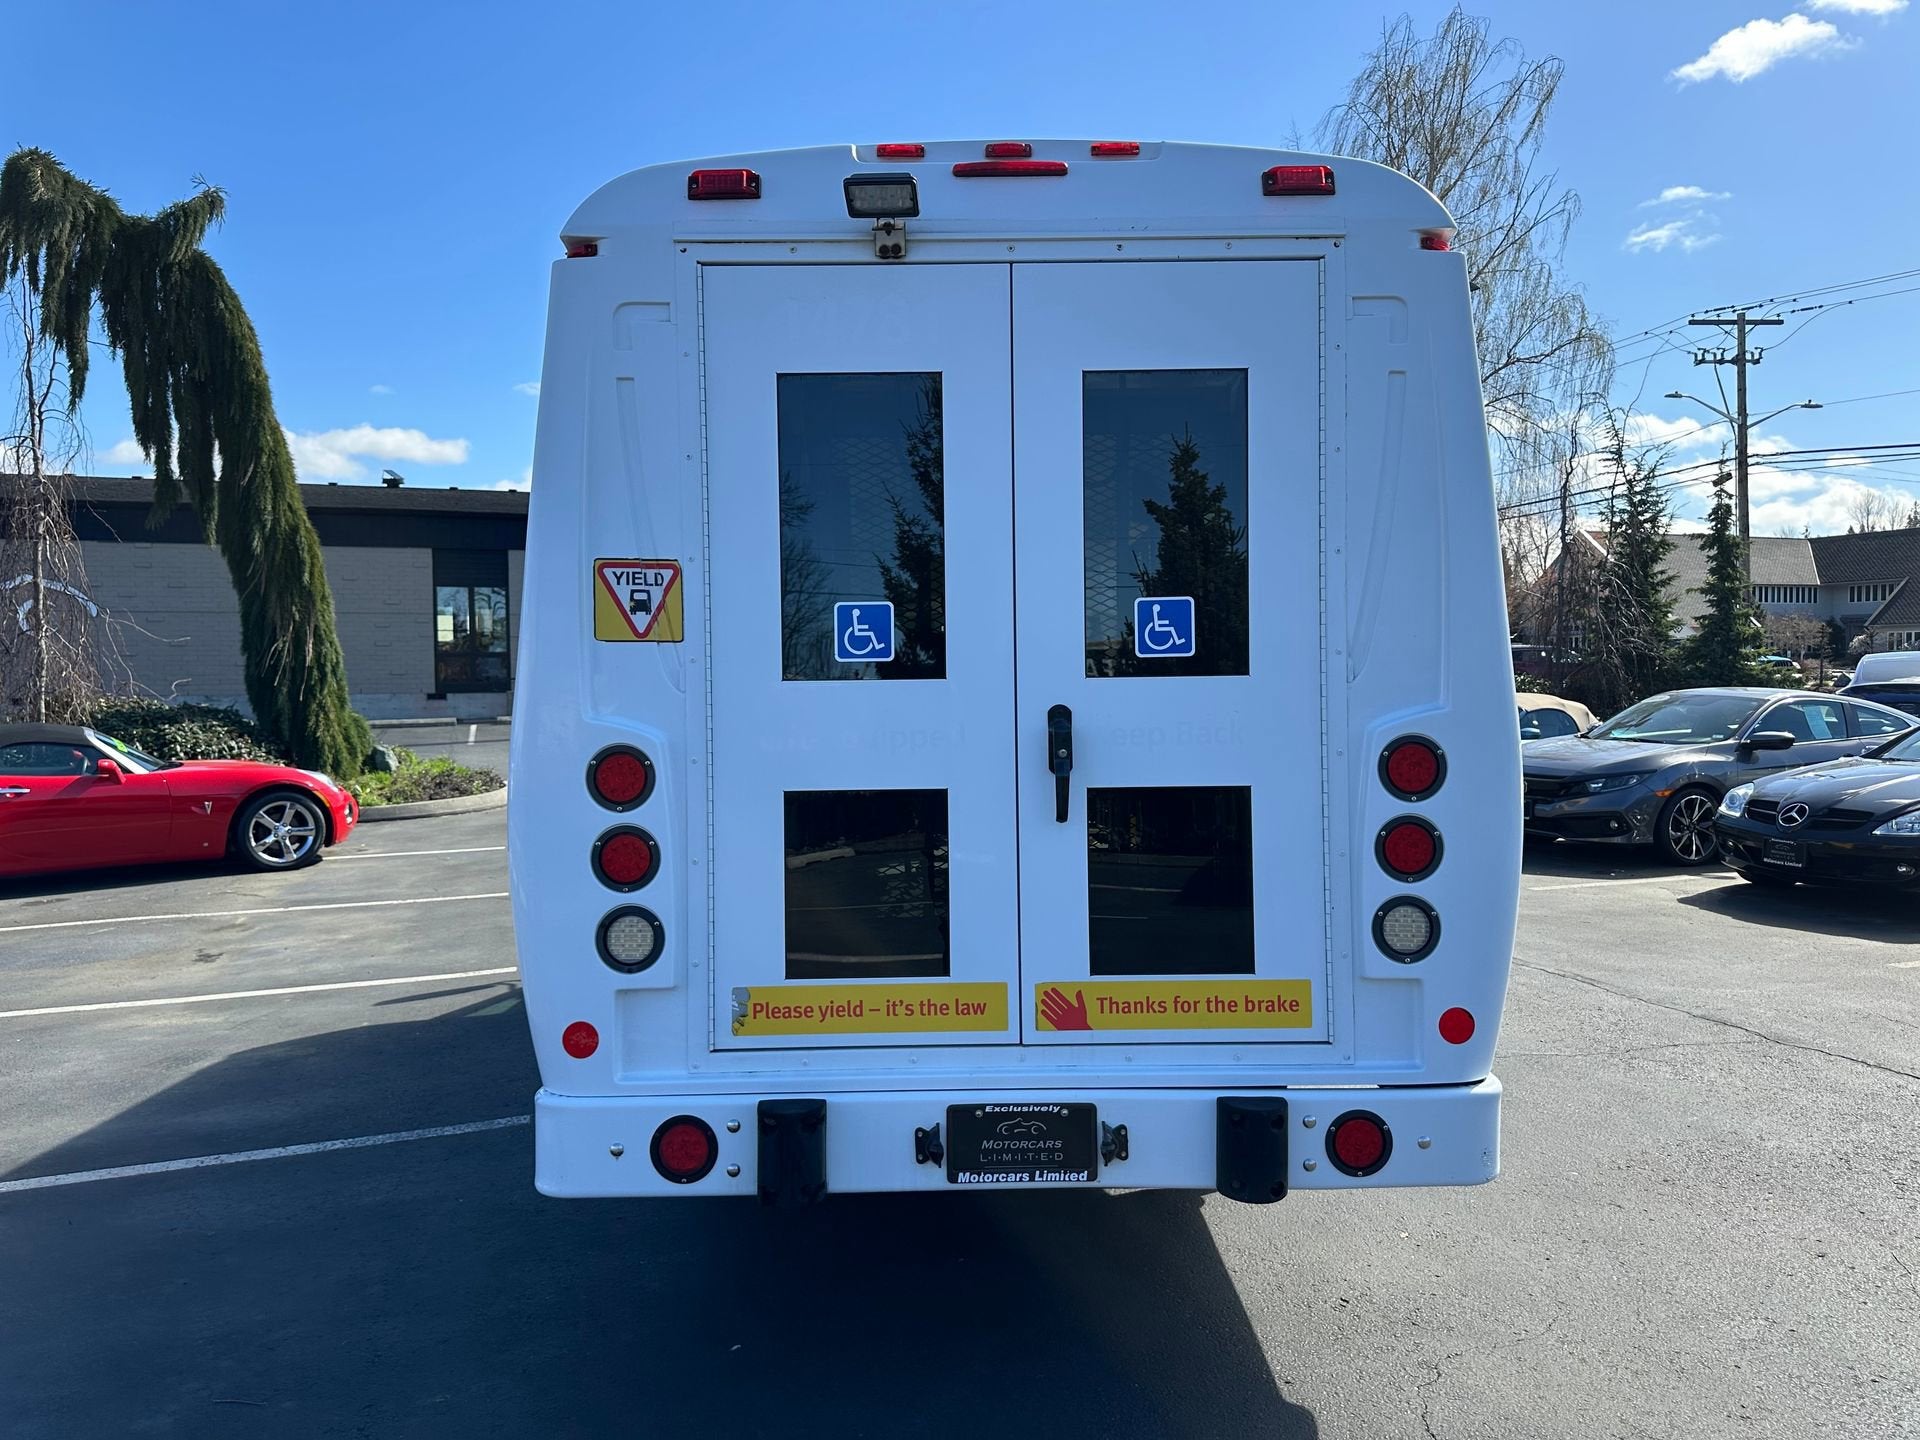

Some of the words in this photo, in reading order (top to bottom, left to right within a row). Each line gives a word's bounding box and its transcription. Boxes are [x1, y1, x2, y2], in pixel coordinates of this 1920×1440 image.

[612, 571, 664, 586] YIELD
[752, 1002, 814, 1020] Please
[819, 1000, 863, 1023] yield
[886, 999, 914, 1017] it’s
[919, 998, 950, 1016] the
[954, 998, 987, 1016] law
[1096, 995, 1168, 1014] Thanks
[1173, 995, 1201, 1014] for
[1207, 996, 1238, 1013] the
[1244, 994, 1300, 1013] brake
[985, 1105, 1061, 1113] Exclusively
[981, 1139, 1063, 1150] MOTORCARS
[957, 1171, 1029, 1183] Motorcars
[1034, 1170, 1088, 1182] Limited
